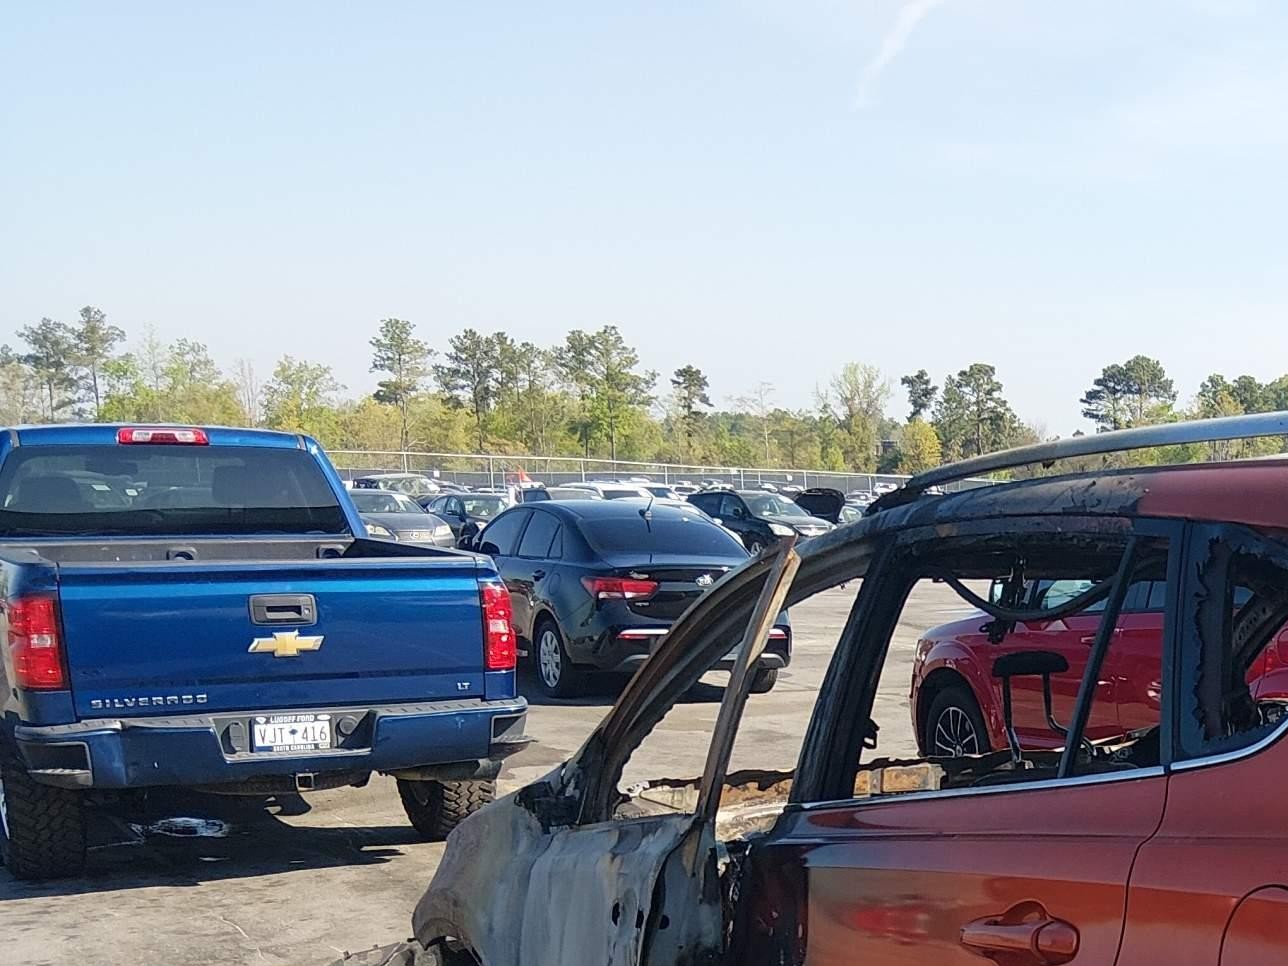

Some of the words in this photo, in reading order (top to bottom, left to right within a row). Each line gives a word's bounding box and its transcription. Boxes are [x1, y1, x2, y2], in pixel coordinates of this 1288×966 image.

[457, 682, 470, 690] LT
[91, 694, 207, 709] SILVERADO
[259, 727, 284, 745] VJT
[302, 726, 327, 742] 416
